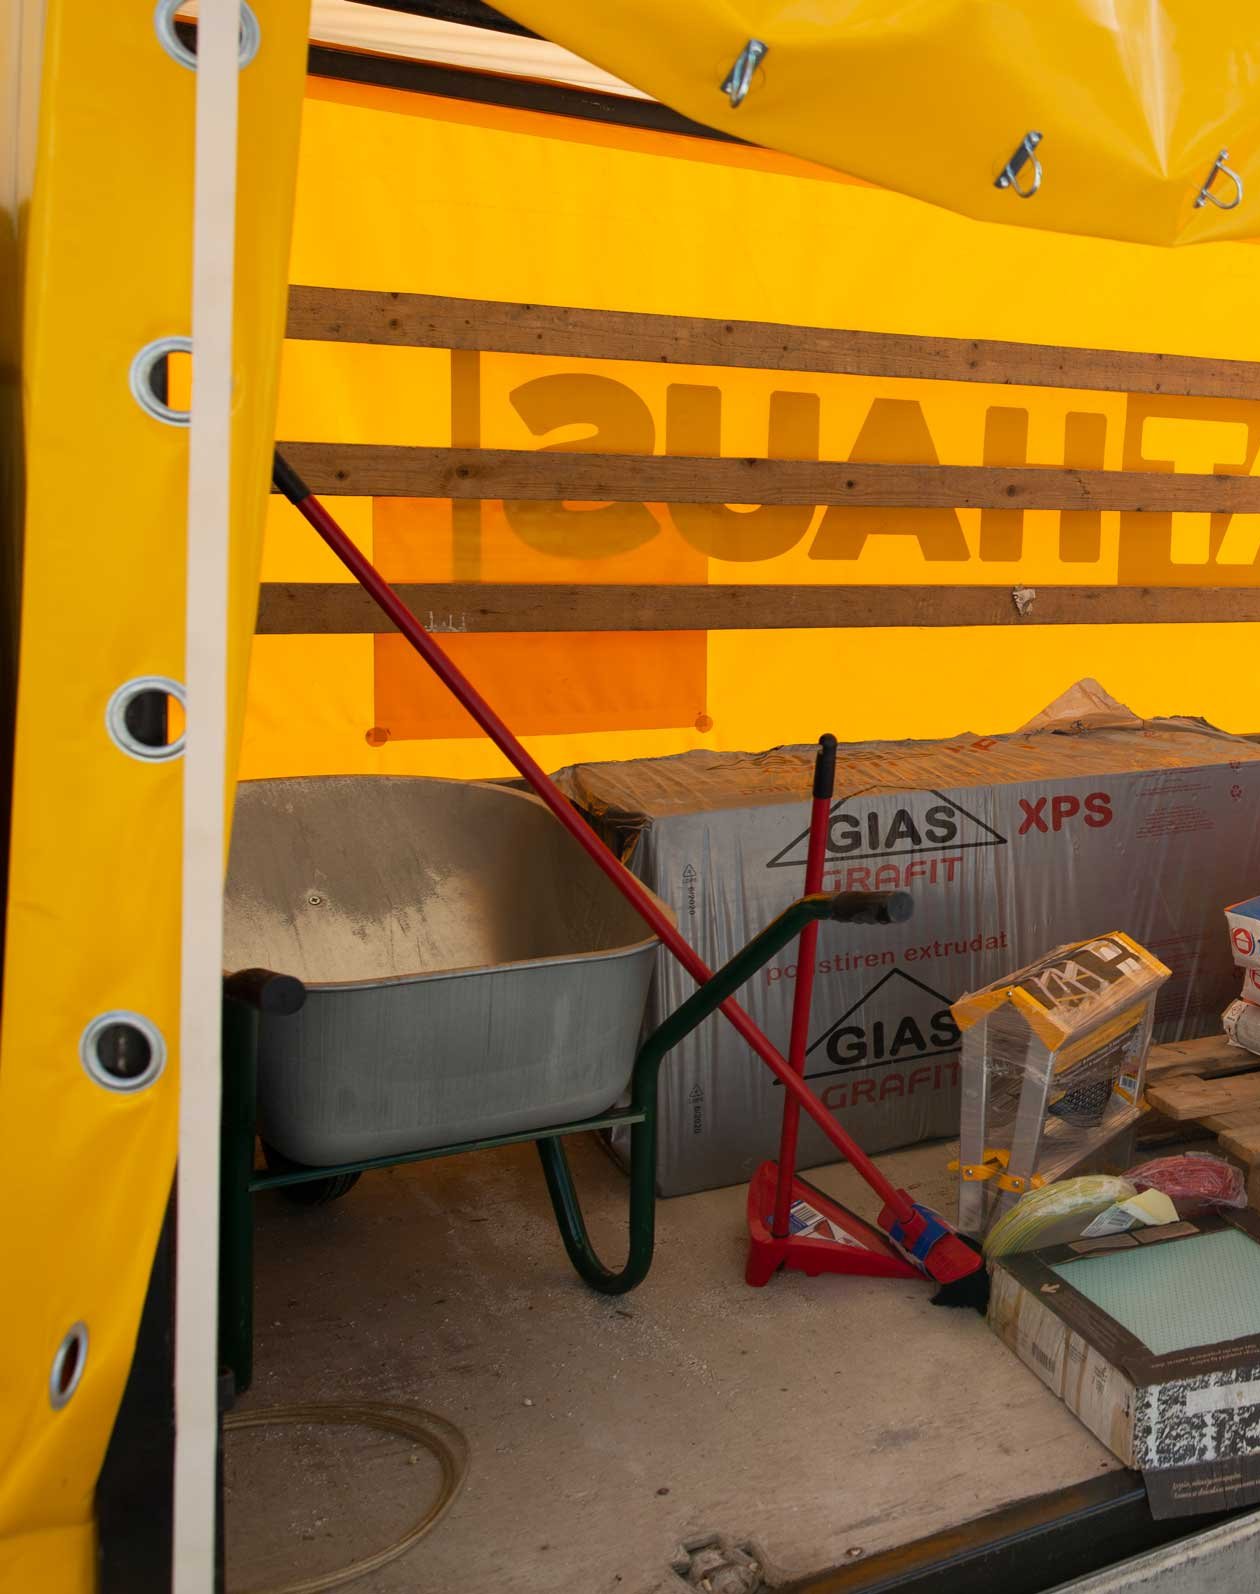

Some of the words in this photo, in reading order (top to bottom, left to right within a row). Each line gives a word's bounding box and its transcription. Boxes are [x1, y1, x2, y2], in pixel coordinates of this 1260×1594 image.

[824, 805, 957, 853] GIAS
[1018, 792, 1113, 835] XPS
[766, 949, 895, 985] postiren
[904, 930, 1008, 962] extrudat
[826, 1009, 961, 1065] GIAS
